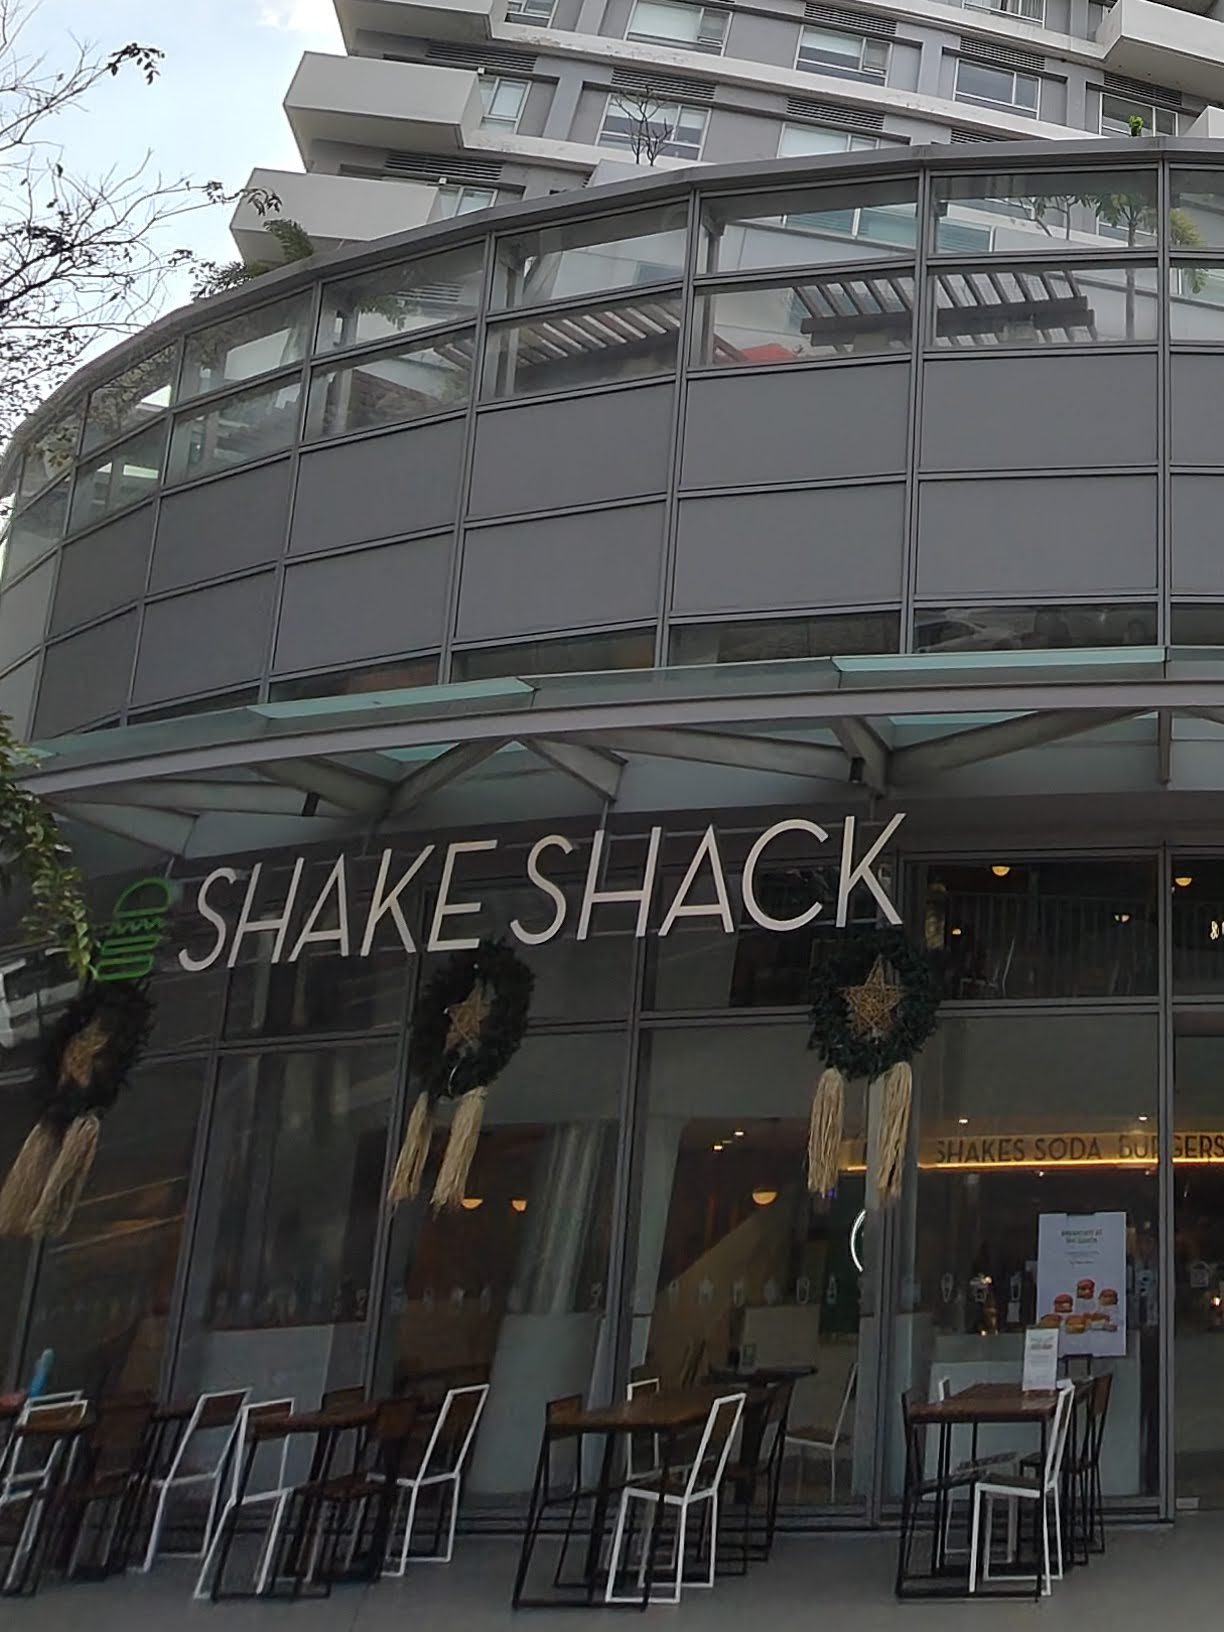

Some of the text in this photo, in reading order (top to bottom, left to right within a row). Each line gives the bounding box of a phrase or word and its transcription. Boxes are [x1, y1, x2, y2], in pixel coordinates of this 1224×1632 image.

[178, 813, 907, 972] SHAKE SHACK
[935, 1137, 1026, 1164] SHAKES
[1028, 1136, 1103, 1161] SODA
